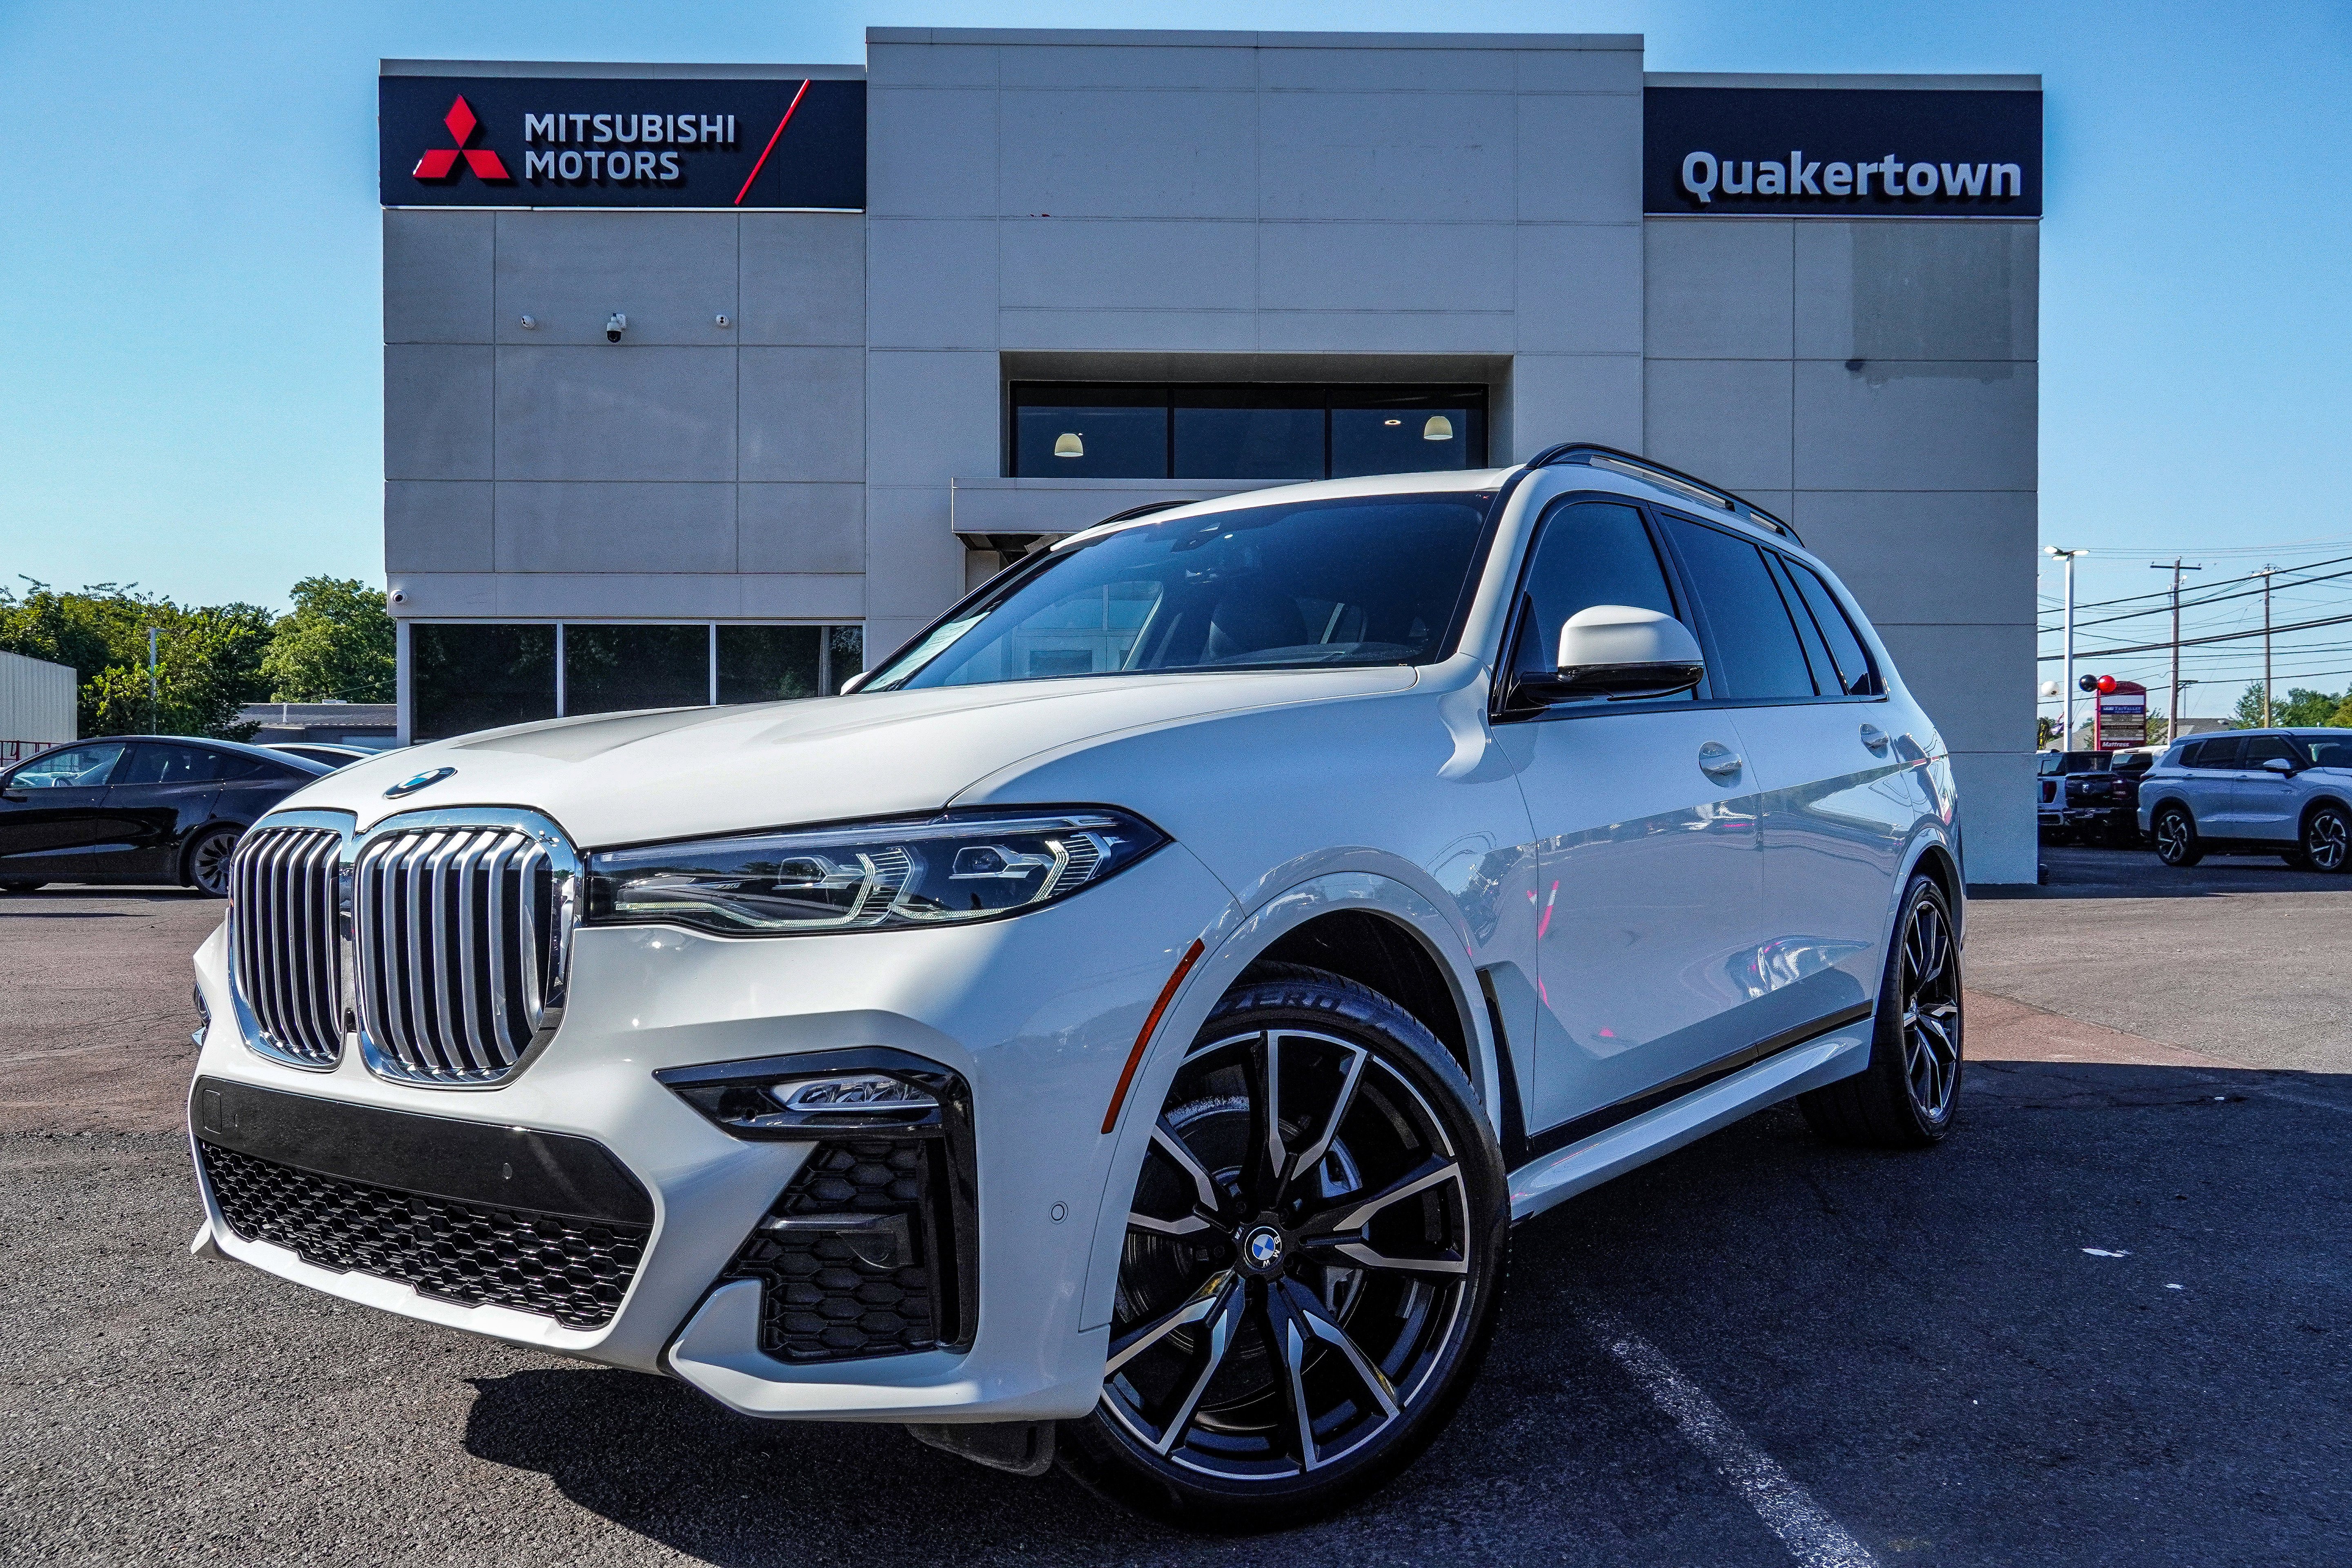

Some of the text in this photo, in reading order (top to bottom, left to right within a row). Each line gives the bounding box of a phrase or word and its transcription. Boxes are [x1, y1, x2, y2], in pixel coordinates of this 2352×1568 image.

[526, 114, 734, 143] MITSUBISHI
[526, 151, 679, 180] MOTORS
[1682, 151, 2021, 202] Quakertown
[1263, 1236, 1281, 1267] BMW
